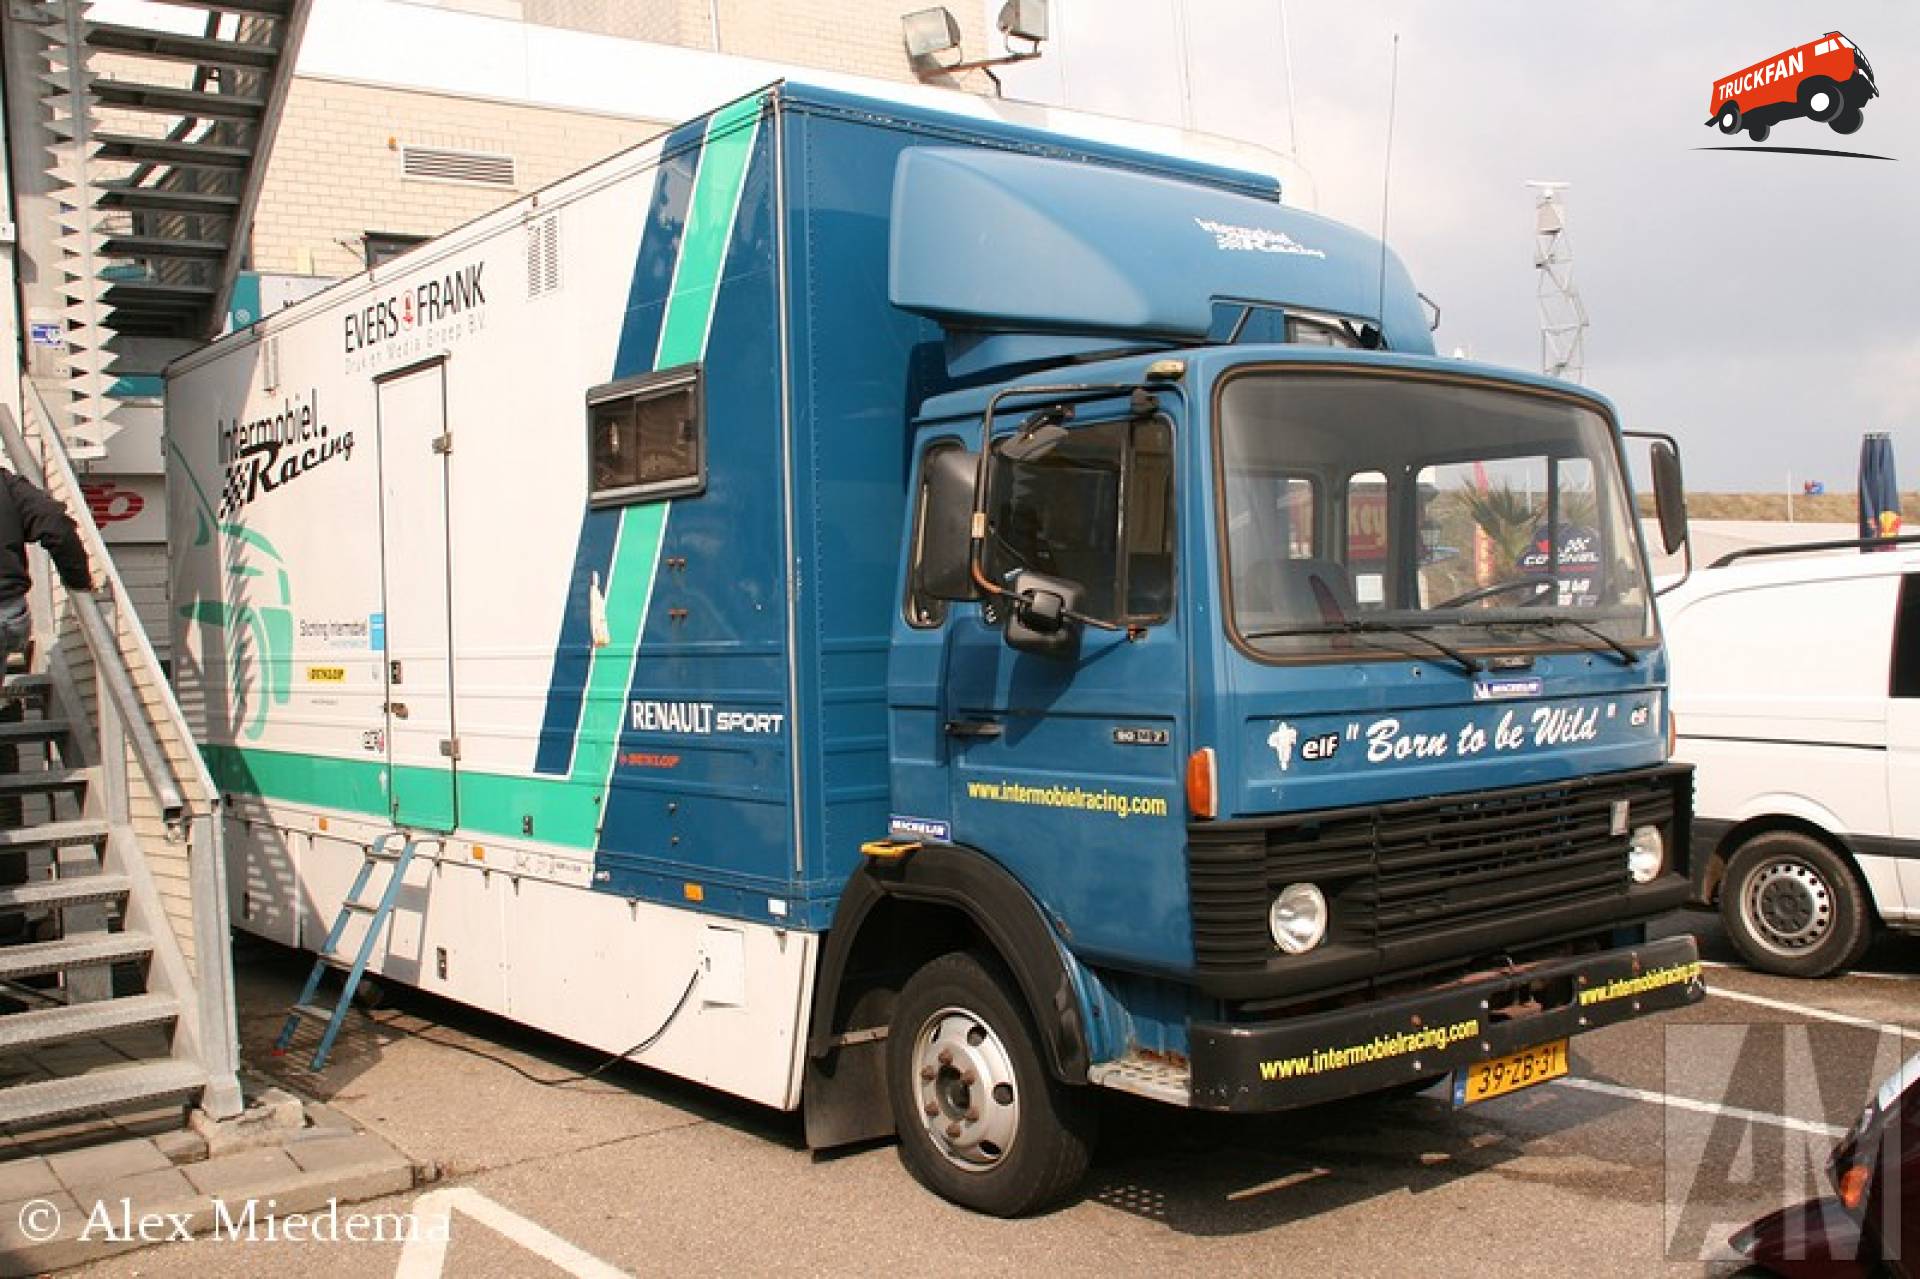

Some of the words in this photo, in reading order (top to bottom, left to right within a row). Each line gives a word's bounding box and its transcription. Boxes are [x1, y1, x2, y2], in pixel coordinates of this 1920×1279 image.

[345, 297, 400, 354] EVERS
[417, 261, 486, 327] FRANK
[239, 425, 355, 504] Racing
[631, 701, 714, 733] RENAULT
[716, 712, 783, 735] SPORT
[1456, 727, 1486, 755] to
[1495, 711, 1525, 750] be
[967, 780, 1167, 818] www.intermobielracing.com
[1259, 1019, 1480, 1081] www.intermobielracing.com
